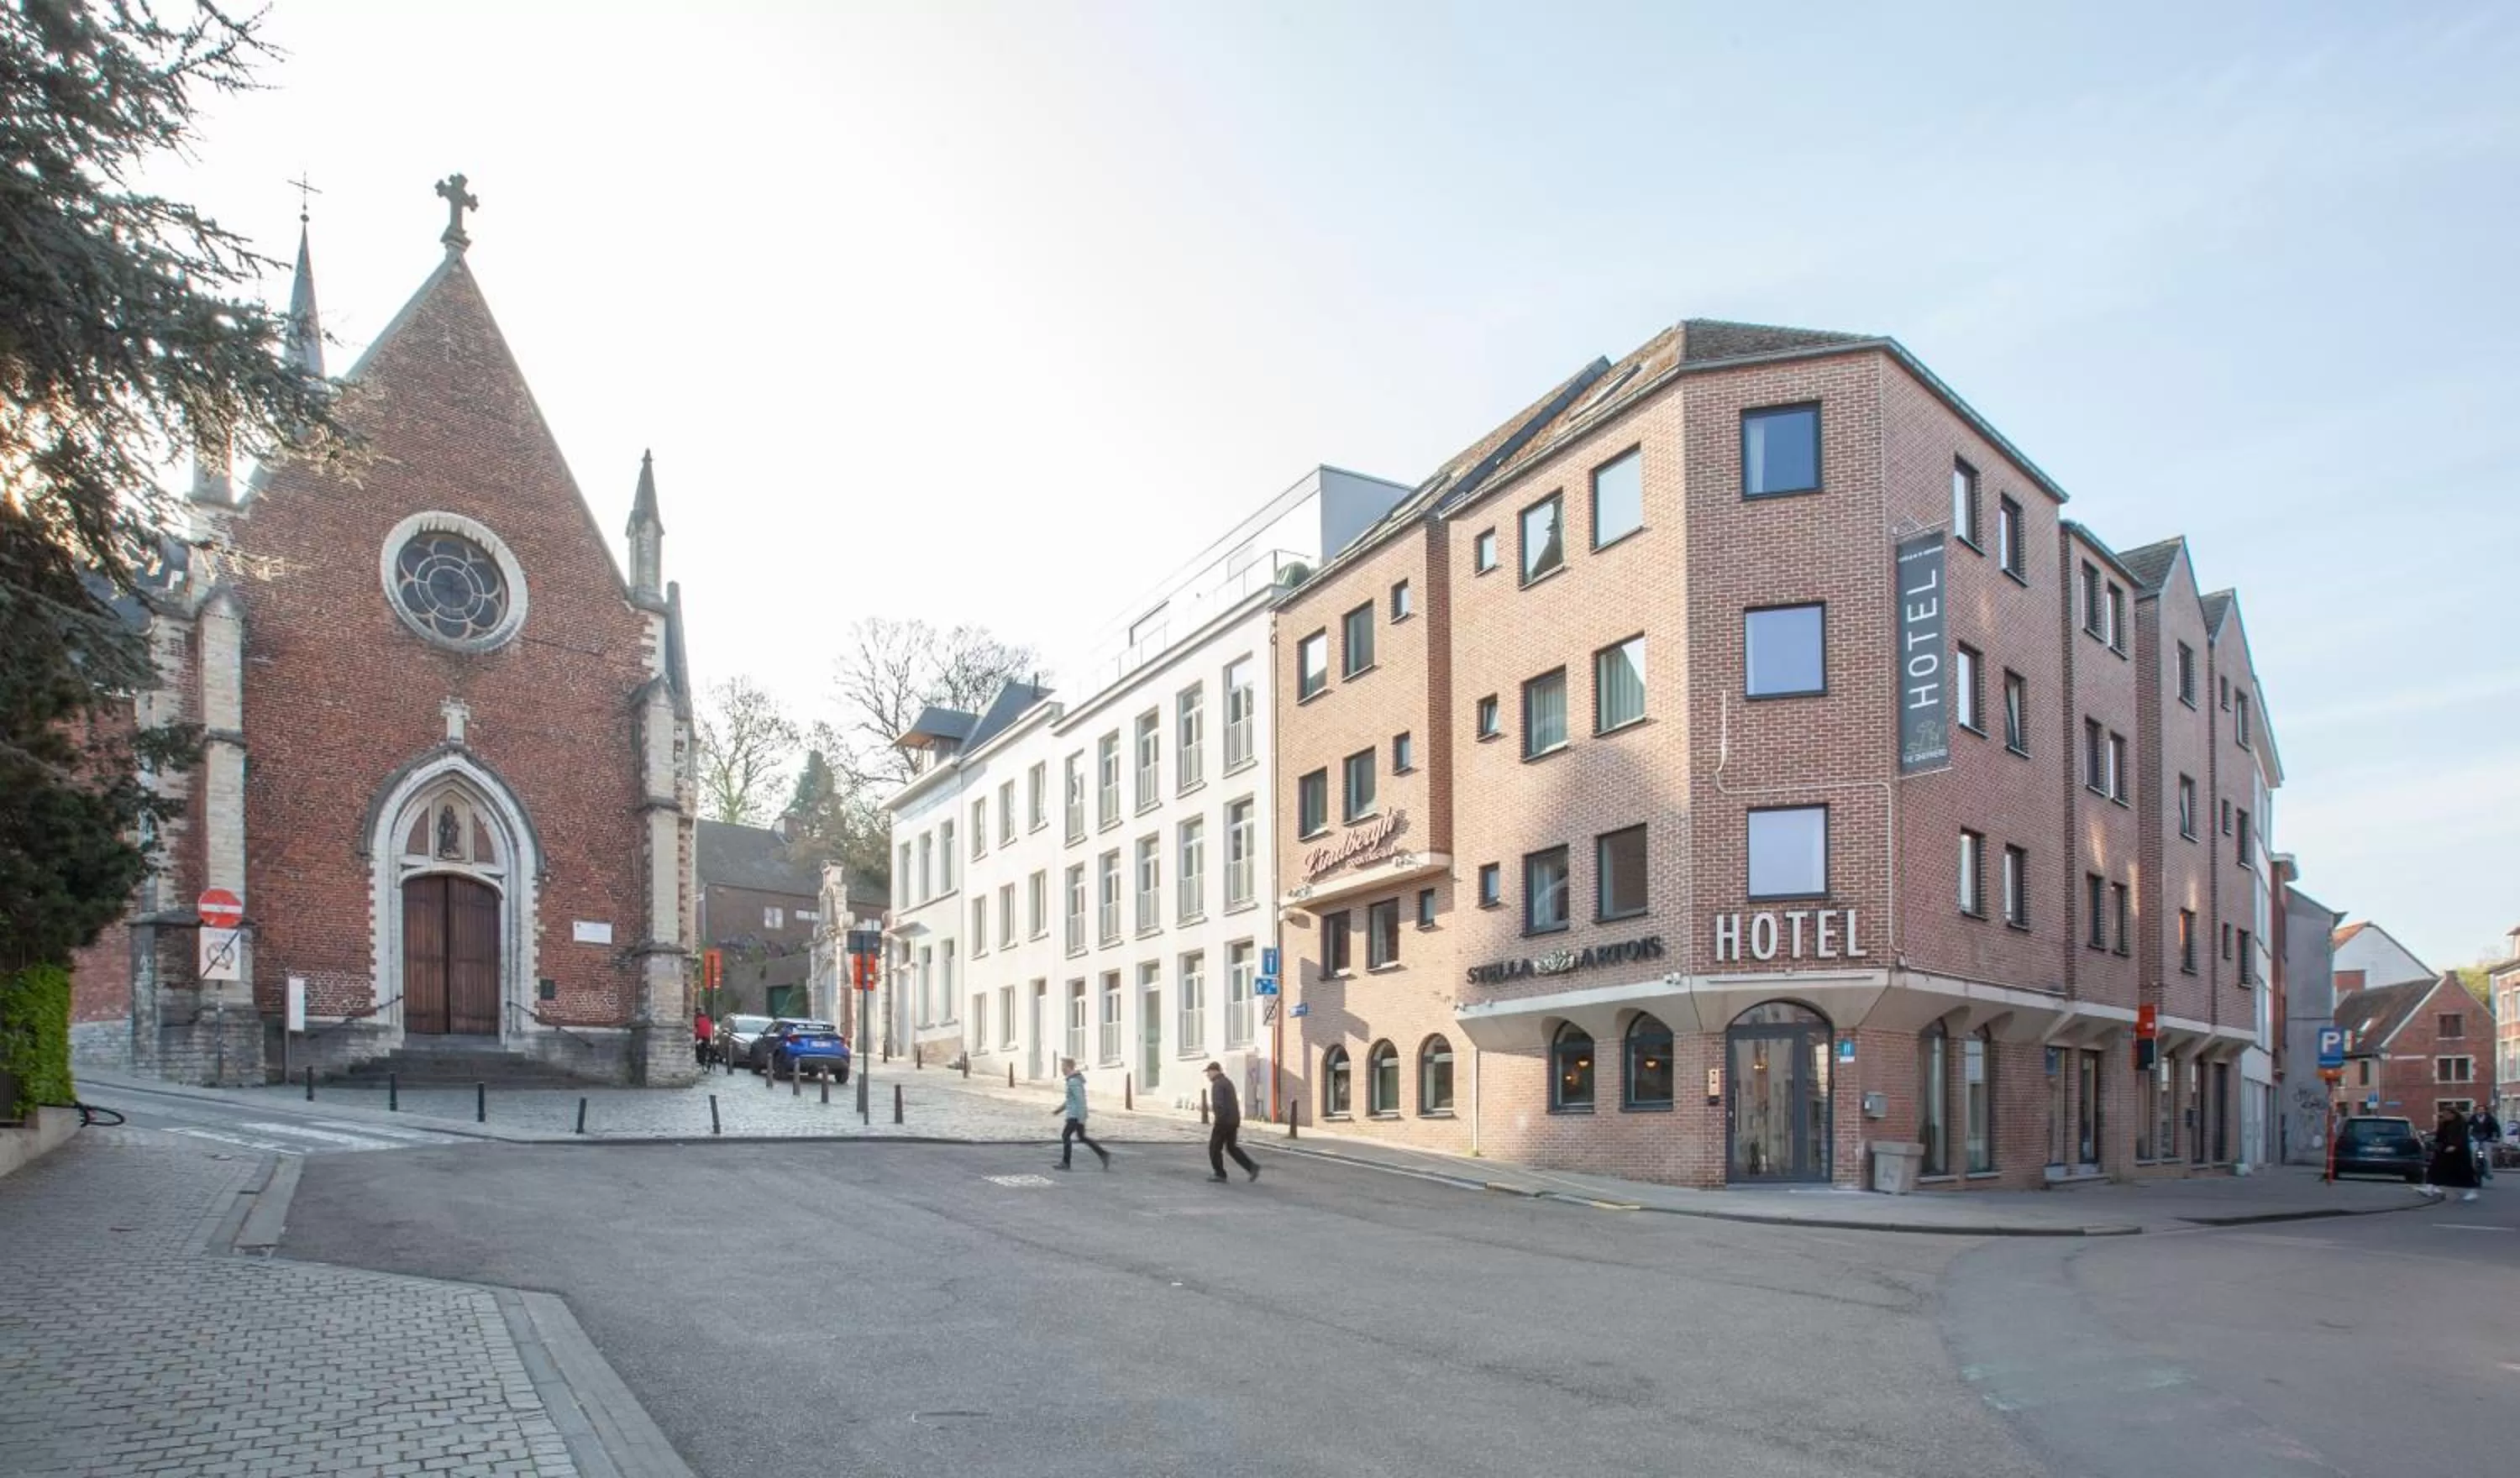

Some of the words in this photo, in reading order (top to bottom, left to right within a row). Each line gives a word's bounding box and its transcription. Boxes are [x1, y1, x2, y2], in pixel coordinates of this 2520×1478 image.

[1906, 569, 1940, 710] HOTEL
[1580, 936, 1663, 968] ARTOIS
[1716, 909, 1867, 962] HOTEL
[2322, 1031, 2340, 1054] P
